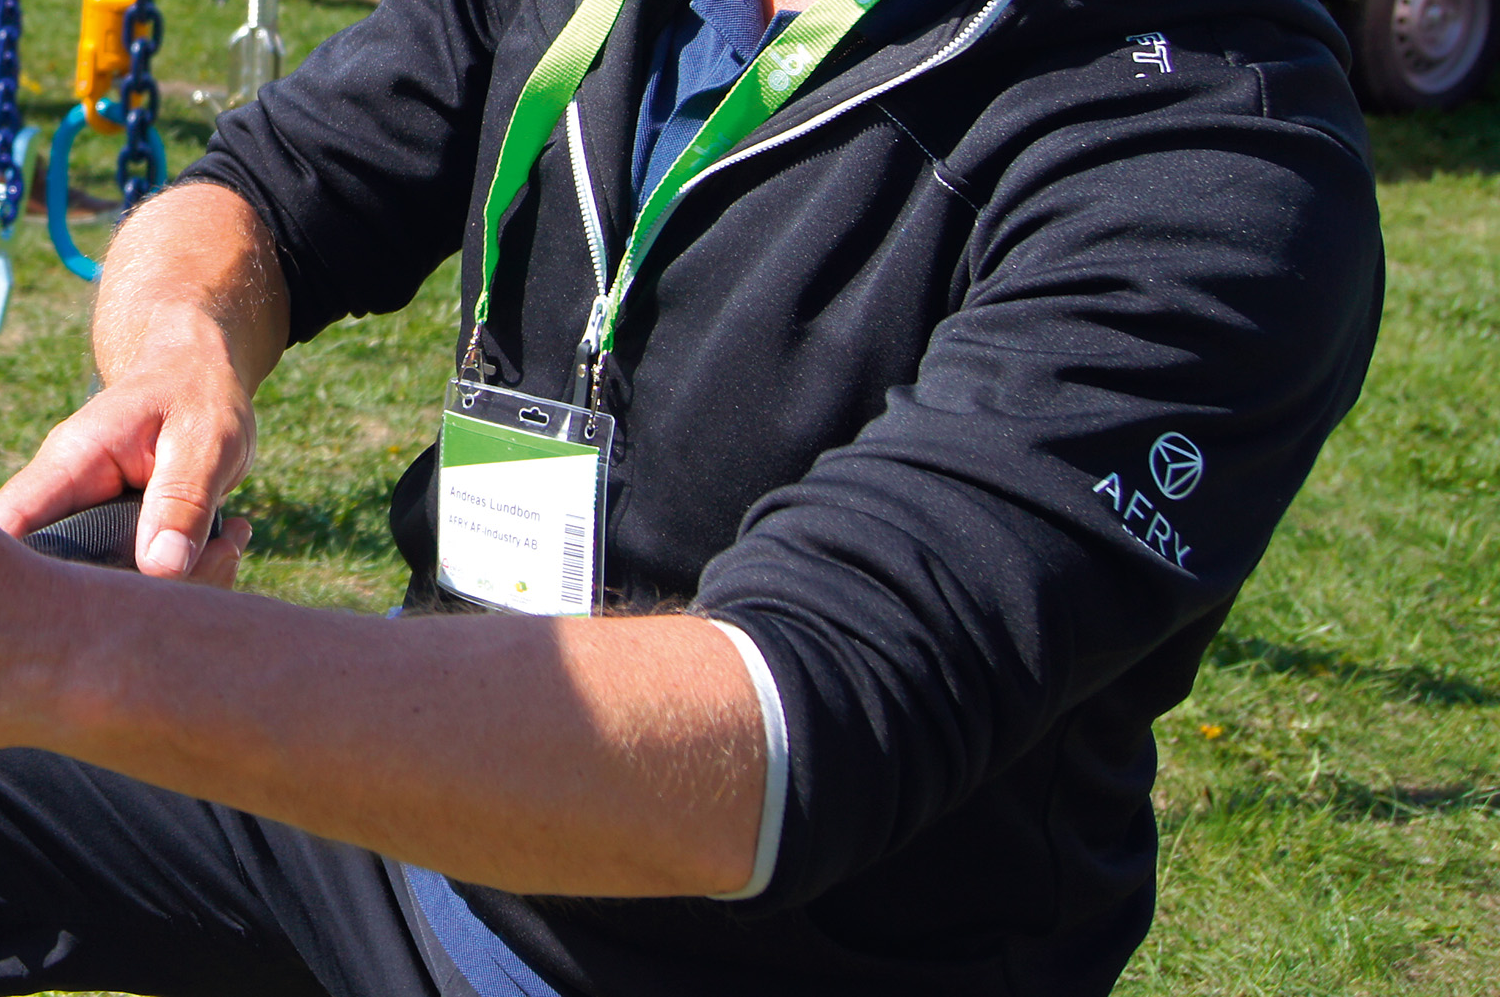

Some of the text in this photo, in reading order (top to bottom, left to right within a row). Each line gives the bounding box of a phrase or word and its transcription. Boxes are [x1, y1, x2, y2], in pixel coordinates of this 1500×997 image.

[450, 486, 541, 522] Andreas Lundbom
[1092, 471, 1192, 567] AFRY
[523, 537, 538, 550] AB
